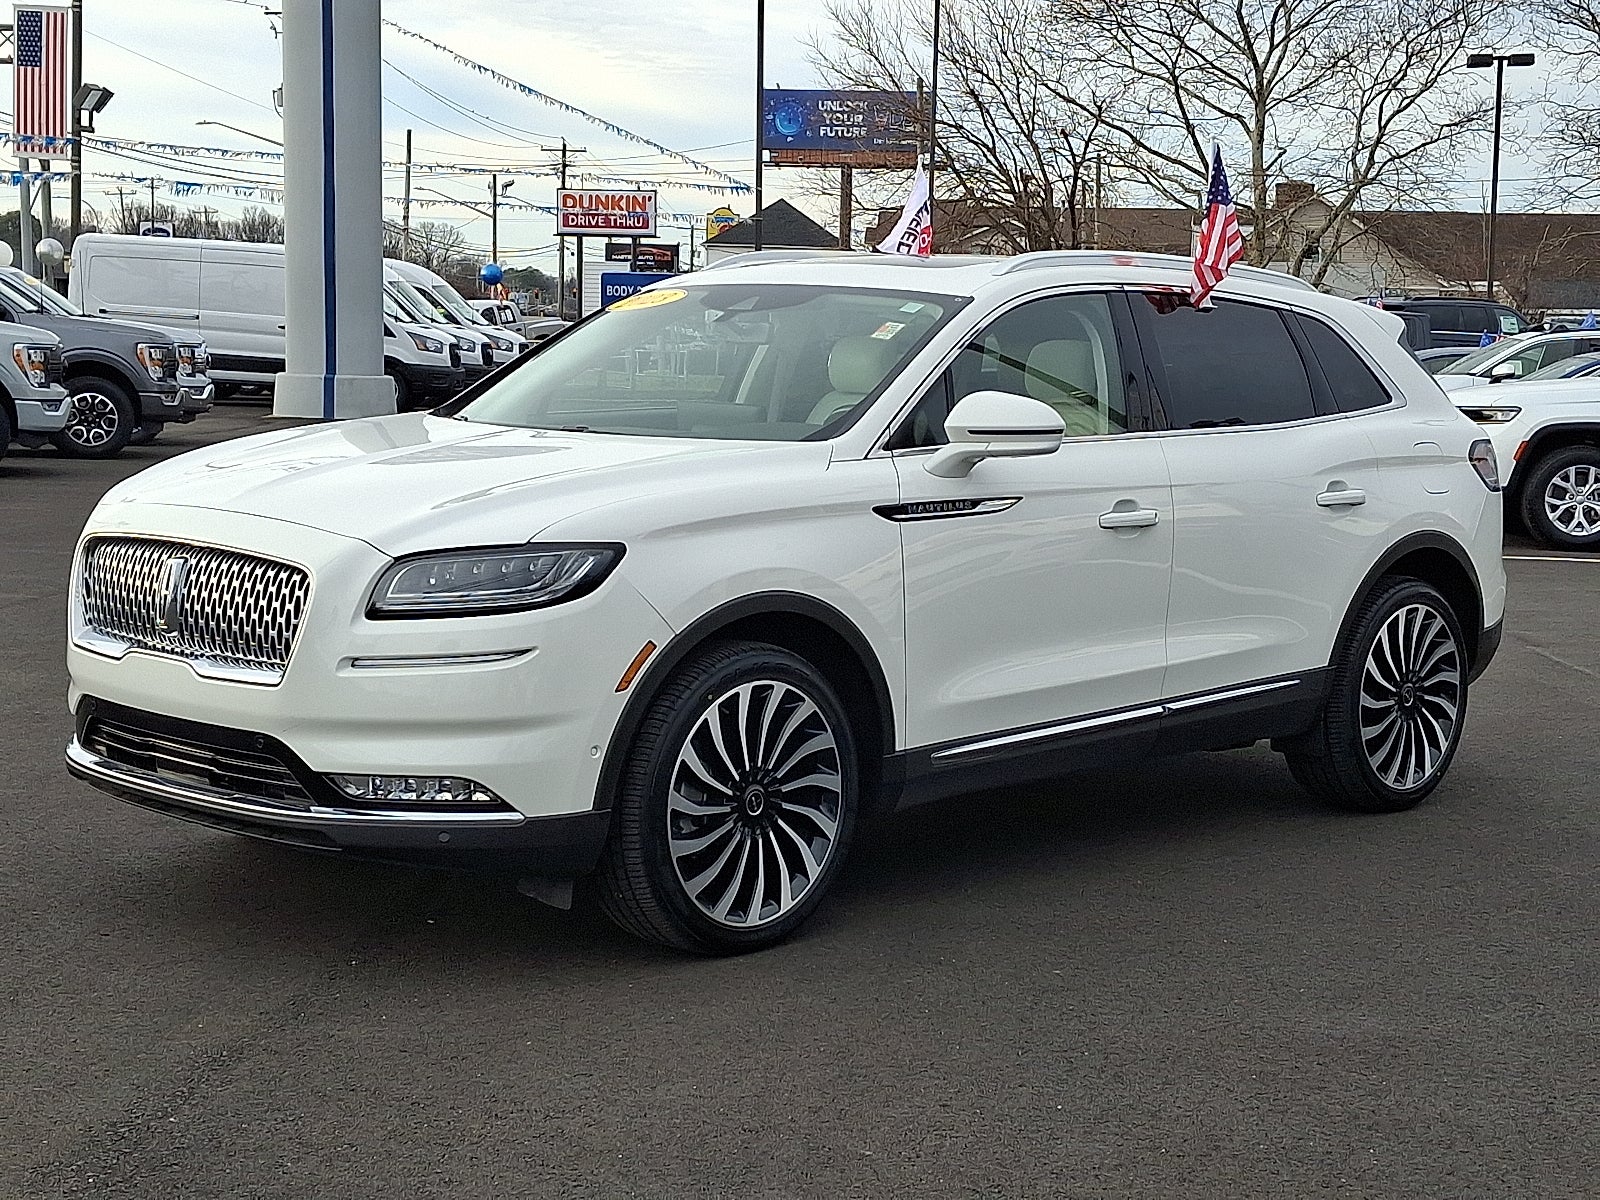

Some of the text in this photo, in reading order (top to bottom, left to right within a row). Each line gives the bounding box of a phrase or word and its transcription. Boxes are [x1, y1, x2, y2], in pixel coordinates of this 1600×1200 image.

[823, 112, 864, 125] YOUR
[820, 126, 868, 138] FUTURE
[562, 193, 653, 212] DUNKIN'
[568, 215, 643, 227] DRIVE THRU
[606, 285, 634, 297] BODY
[908, 500, 973, 514] NAUTILUS
